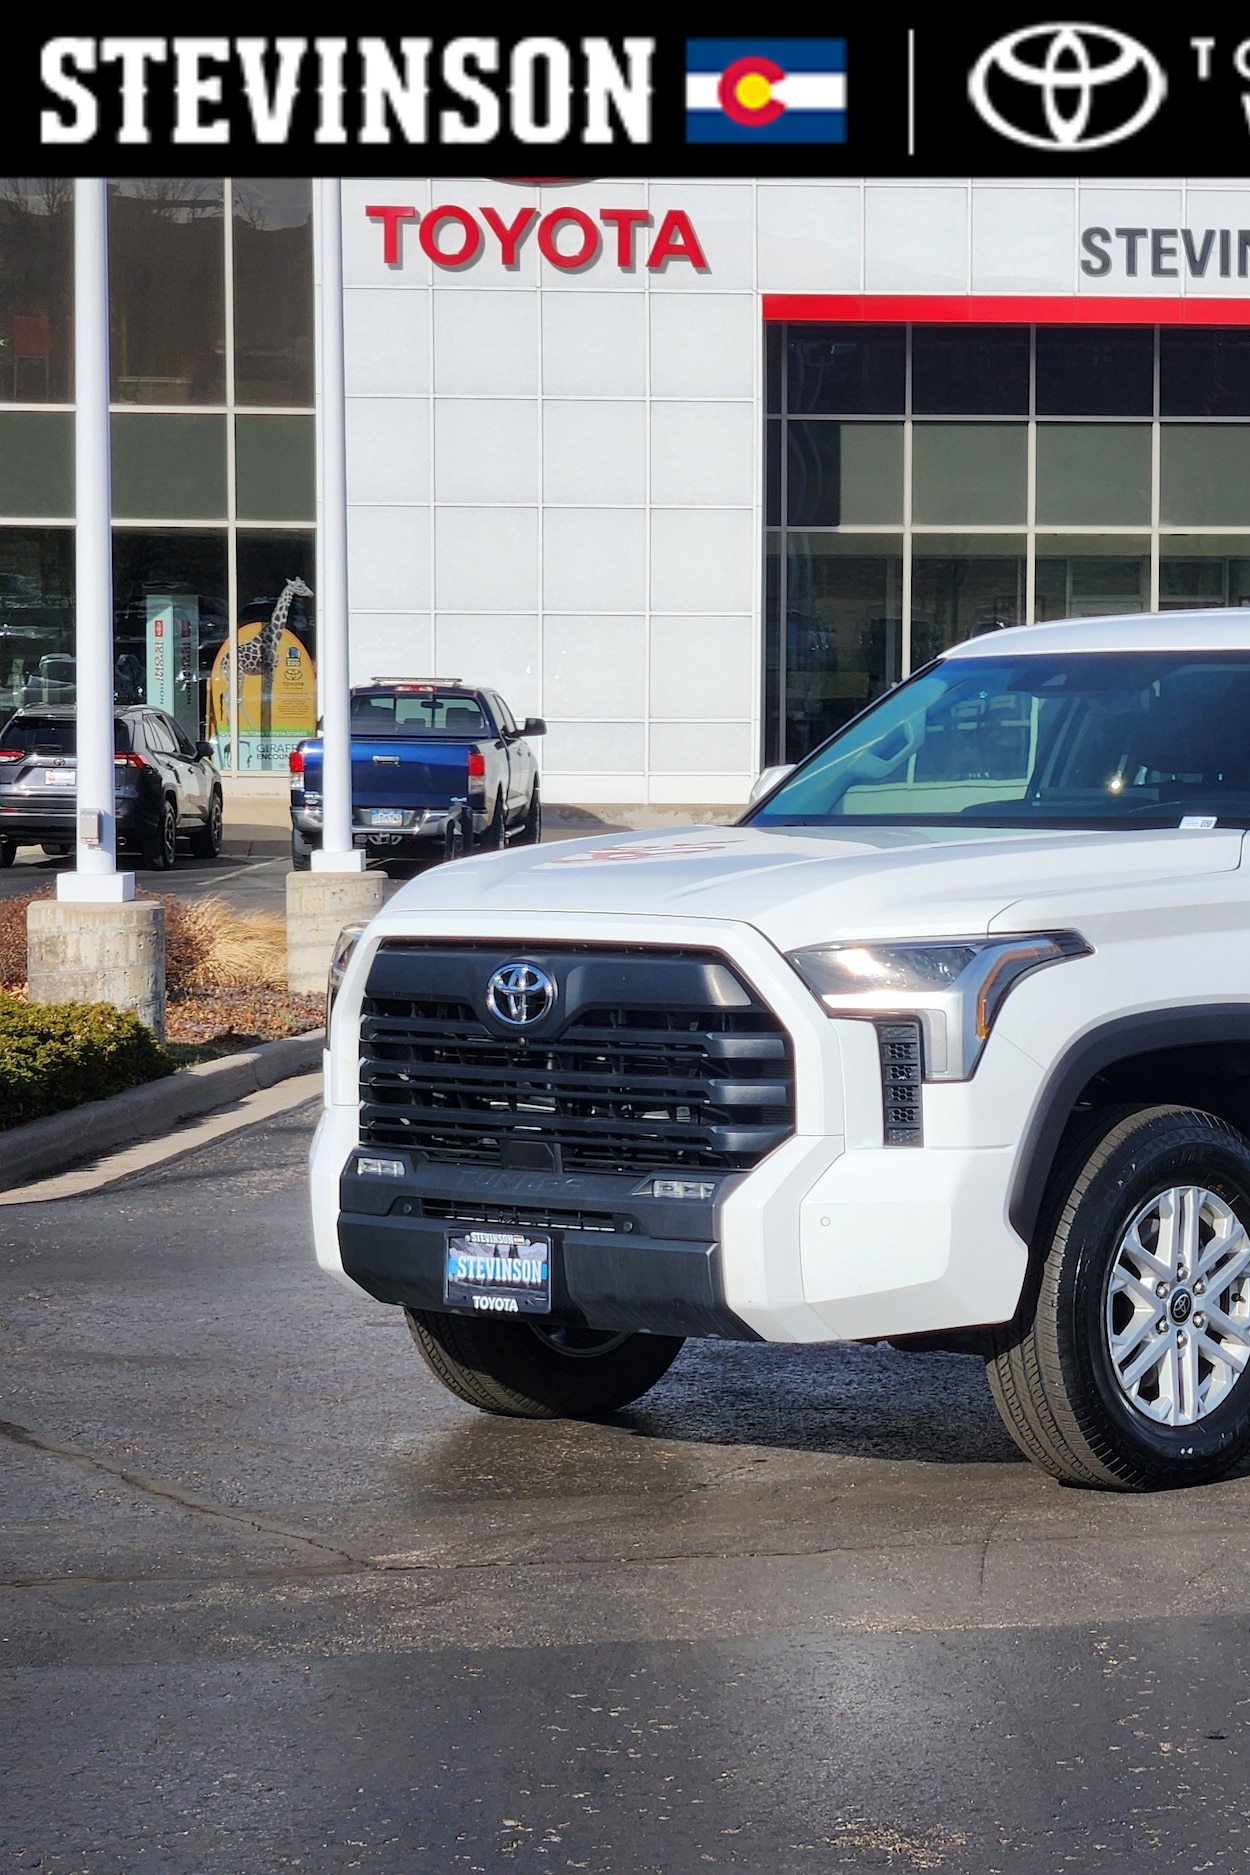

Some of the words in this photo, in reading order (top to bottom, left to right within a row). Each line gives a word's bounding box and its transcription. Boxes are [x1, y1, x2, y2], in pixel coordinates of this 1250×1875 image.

[365, 205, 709, 272] TOYOTA
[256, 743, 298, 753] GIRAFF
[470, 1231, 515, 1245] STEVINSON
[456, 1255, 543, 1284] STEVINSON
[472, 1295, 519, 1312] TOYOTA
